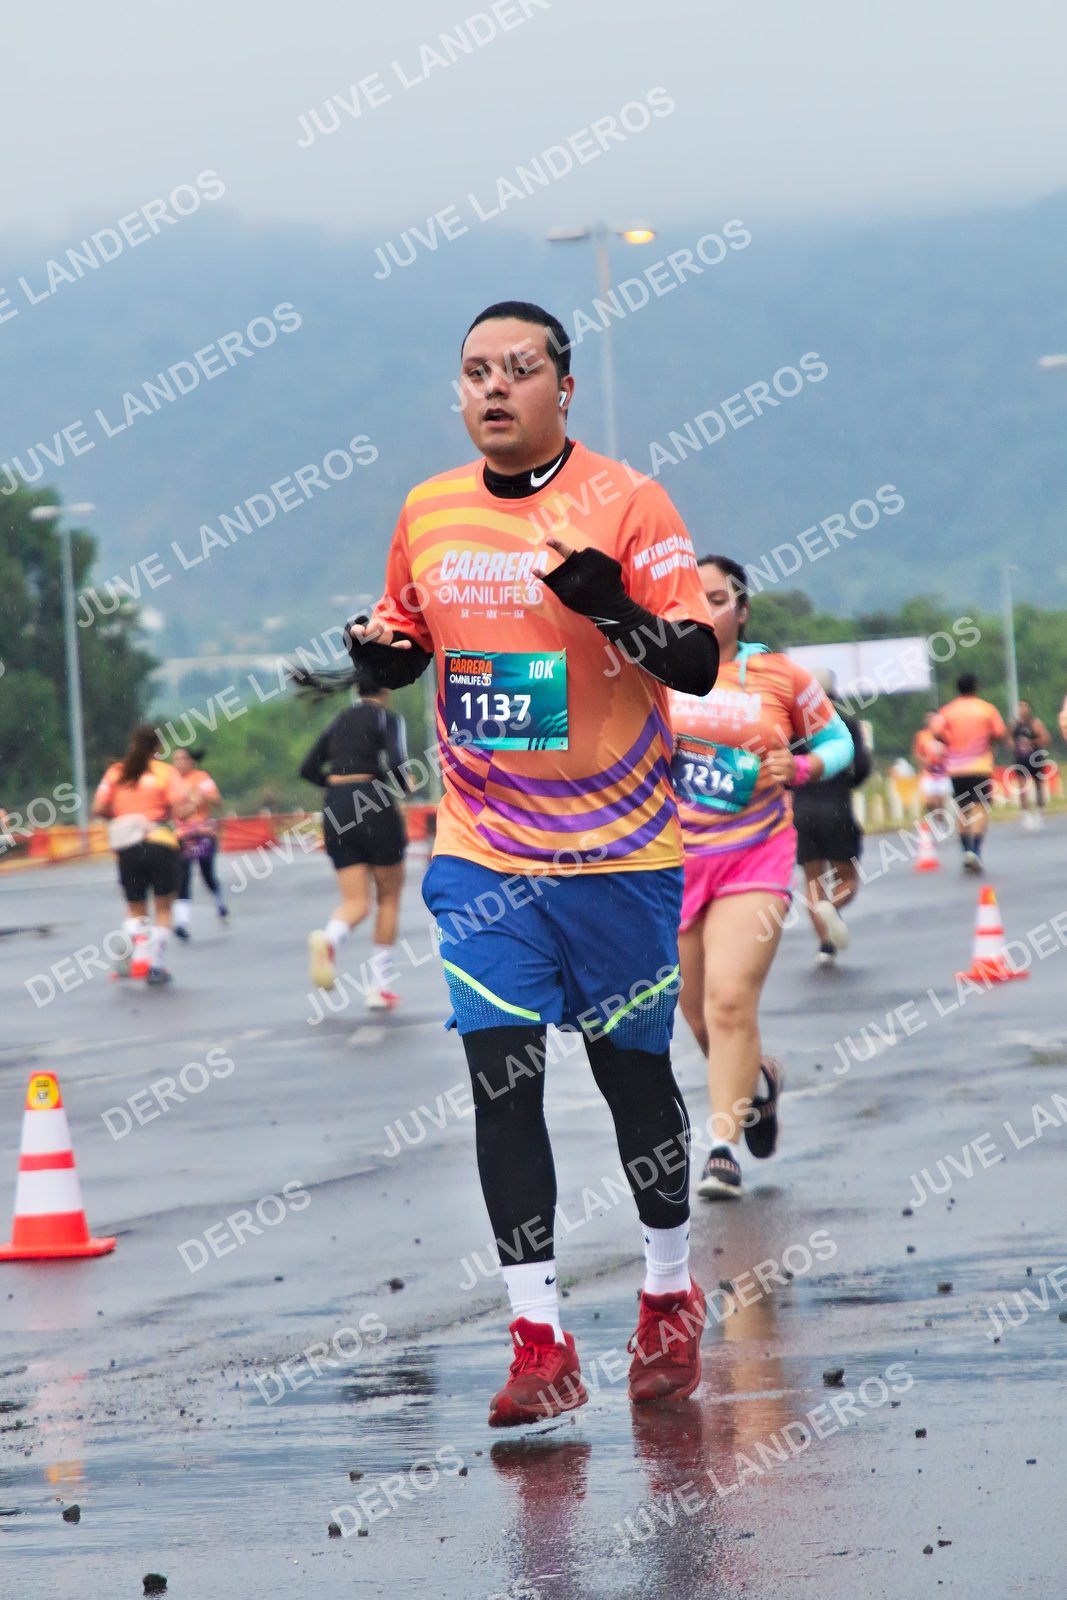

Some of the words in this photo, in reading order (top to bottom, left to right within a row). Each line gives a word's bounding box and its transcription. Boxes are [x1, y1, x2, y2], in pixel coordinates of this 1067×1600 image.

[440, 550, 549, 582] CARRERA
[450, 658, 493, 675] CARRERA
[528, 660, 555, 680] 10K
[460, 692, 532, 722] 1137
[684, 763, 734, 793] 1214
